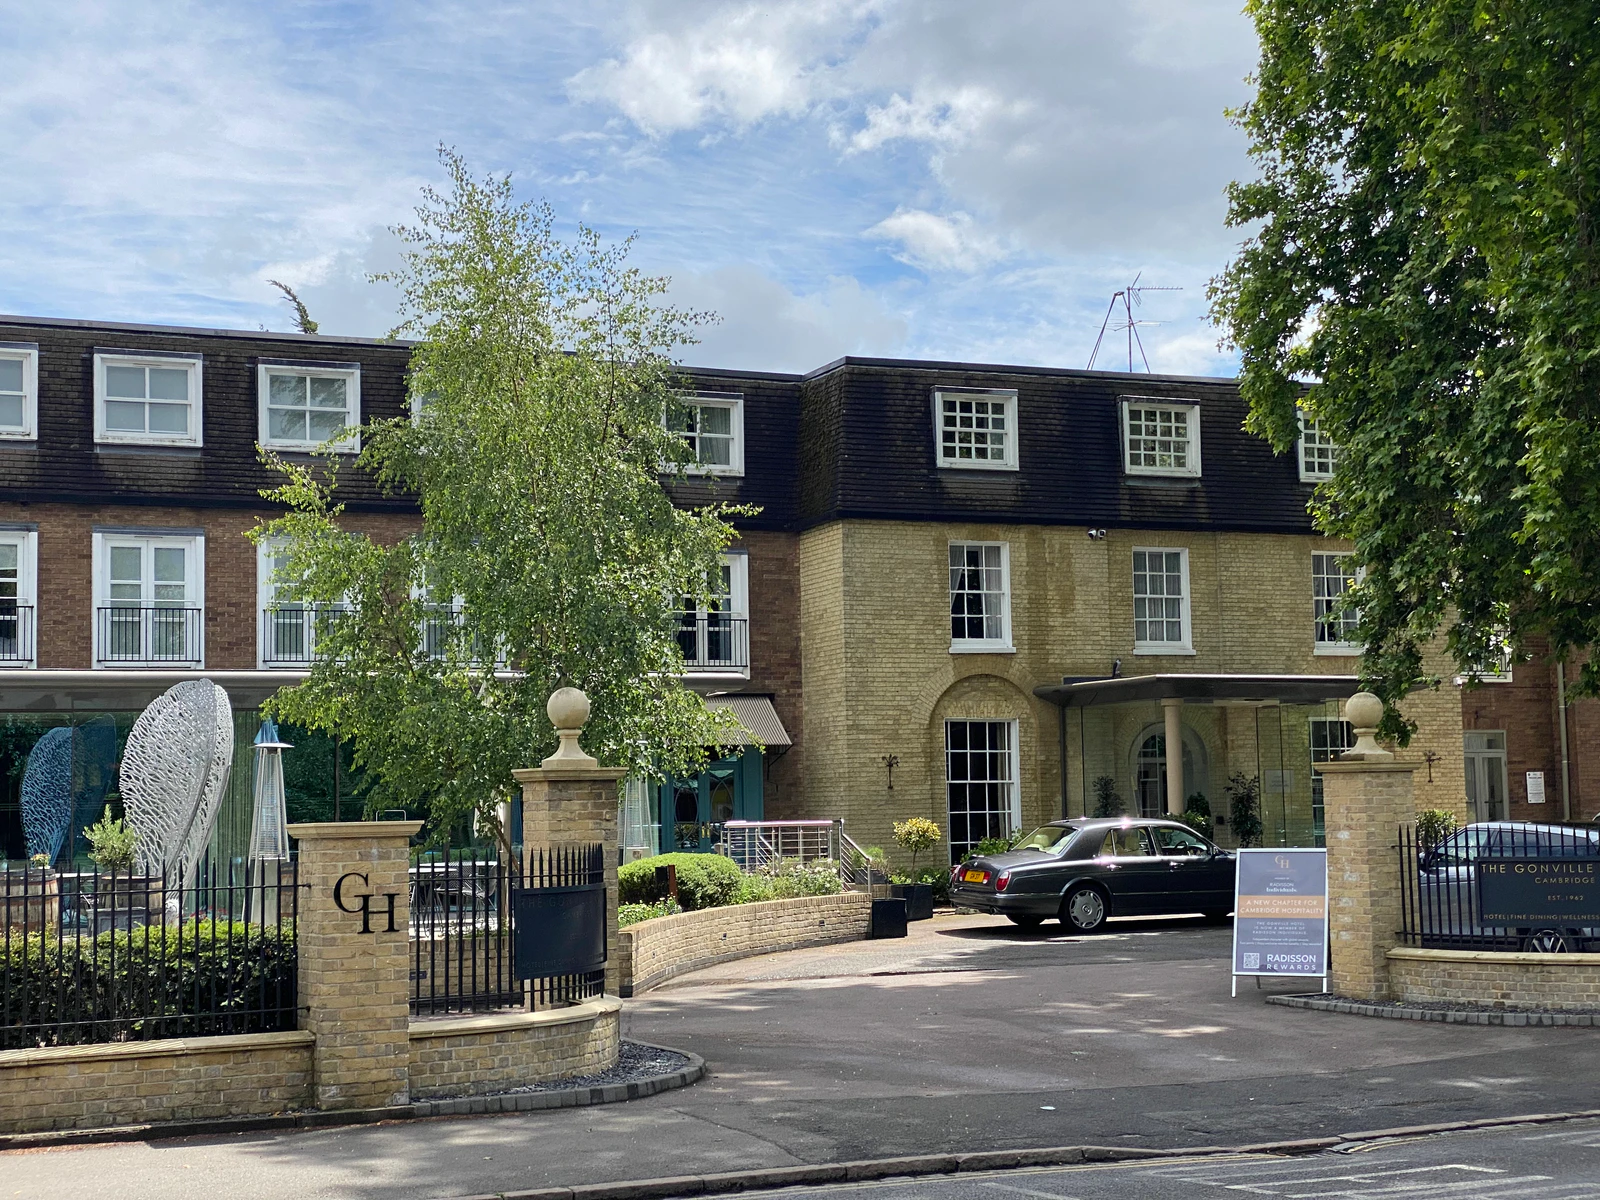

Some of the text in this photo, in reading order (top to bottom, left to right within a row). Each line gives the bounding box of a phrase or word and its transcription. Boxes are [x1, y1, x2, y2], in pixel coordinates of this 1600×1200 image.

[1481, 863, 1593, 874] THE GONVILLE
[333, 872, 400, 935] GH
[1266, 954, 1317, 963] RADISSON
[1266, 963, 1316, 971] REWARDS
